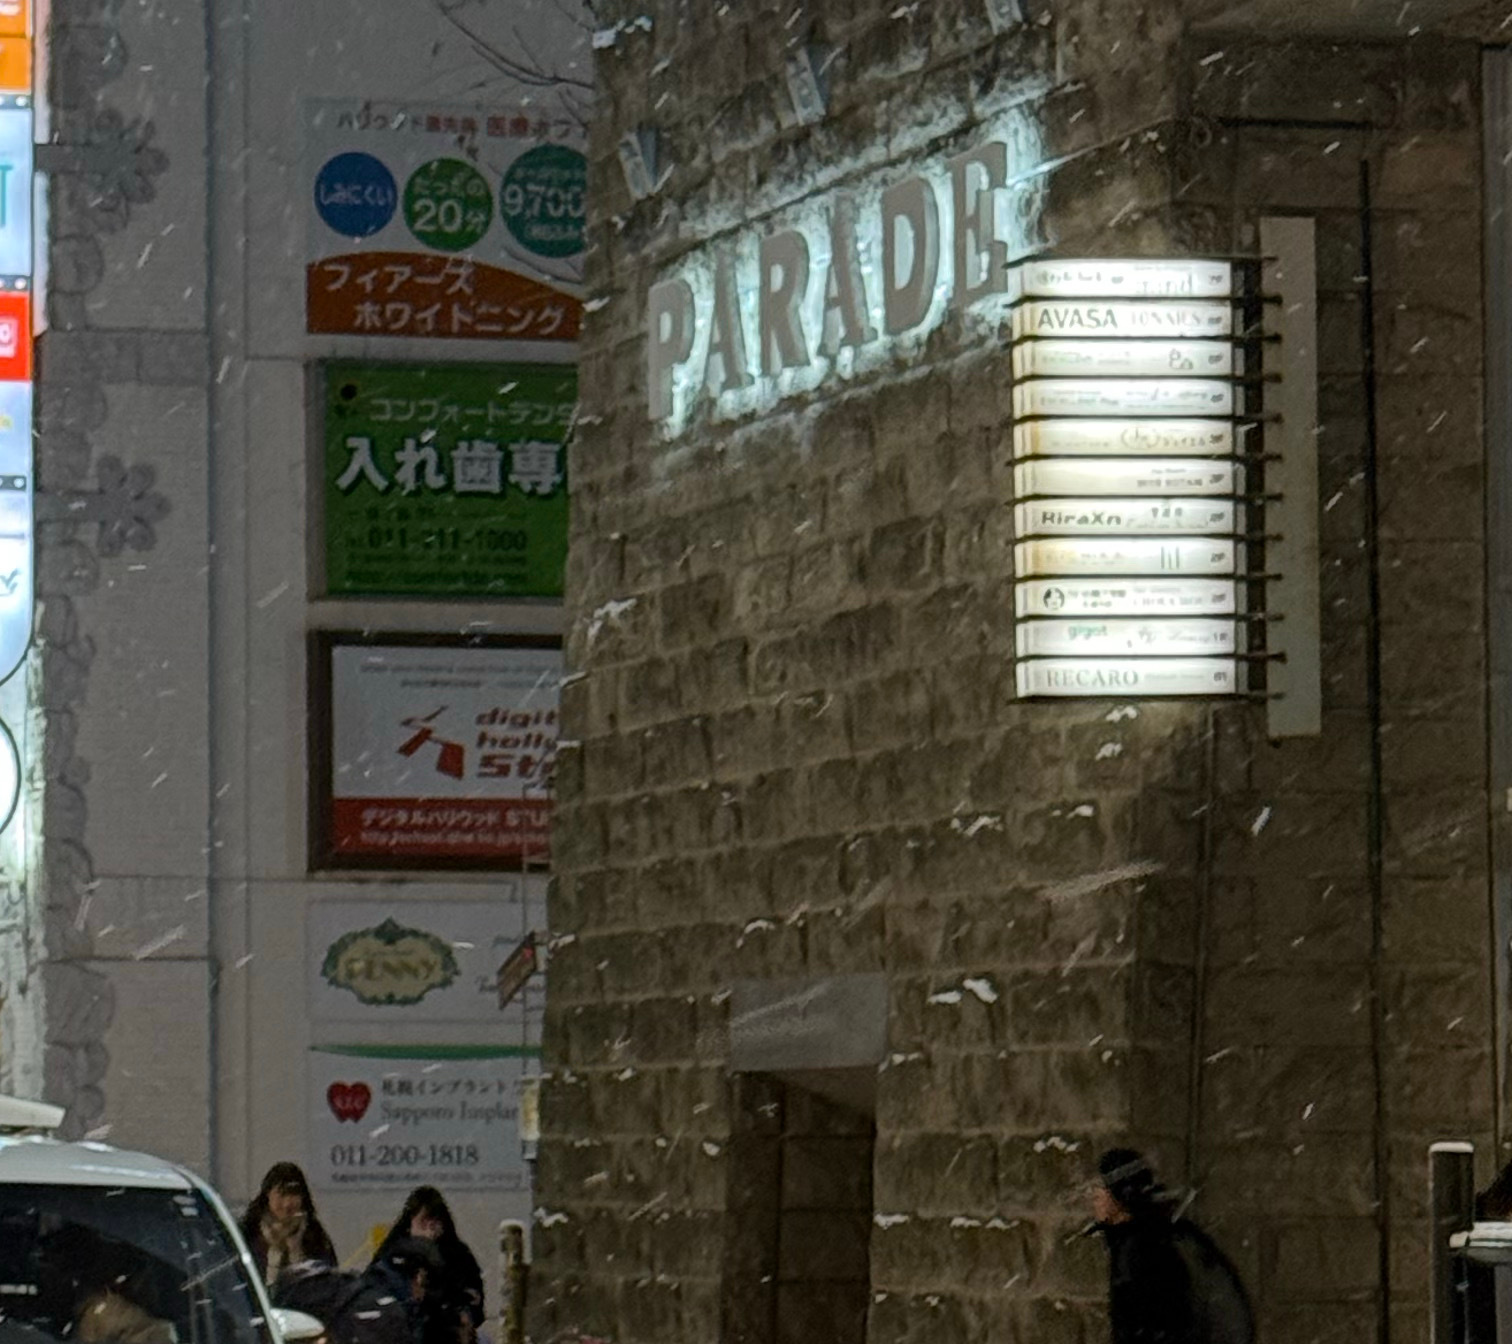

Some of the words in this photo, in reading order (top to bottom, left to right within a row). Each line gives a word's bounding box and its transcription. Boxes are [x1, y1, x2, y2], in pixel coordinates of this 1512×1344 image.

[648, 140, 1008, 422] PARADE
[1037, 307, 1119, 330] AVASA
[335, 434, 565, 497] 入れ歯専
[329, 1143, 480, 1168] 011-200-1818
